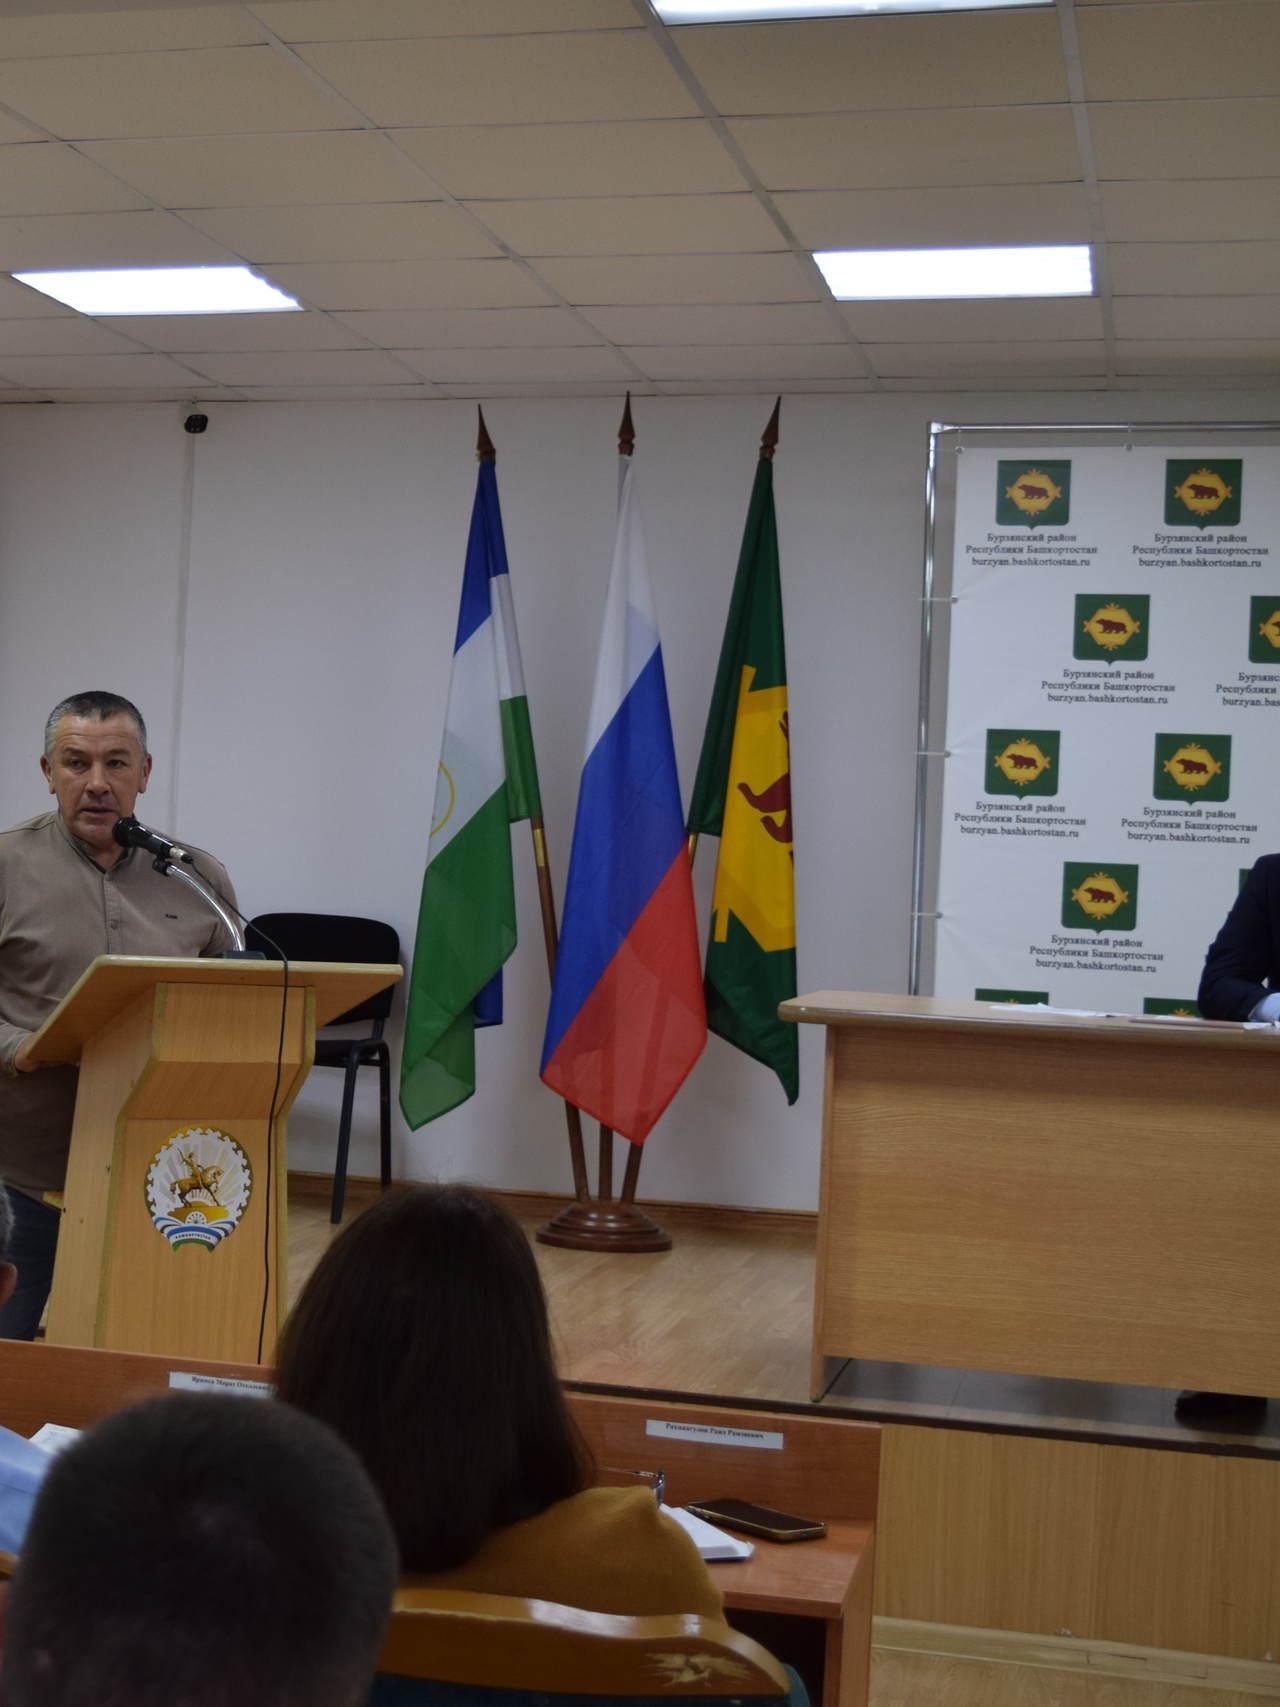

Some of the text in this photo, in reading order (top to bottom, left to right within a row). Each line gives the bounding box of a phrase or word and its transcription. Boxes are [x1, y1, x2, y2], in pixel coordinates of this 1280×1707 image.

[987, 534, 1077, 543] Бурзянский район
[1154, 534, 1247, 544] Бурзянский район
[966, 545, 1097, 555] Республики Башкортостан
[1132, 546, 1269, 556] Республики Башкортостан
[972, 557, 1090, 568] burzyan.bashkortostan.ru
[1139, 557, 1261, 569] burzyan.bashkortostan.ru
[1063, 669, 1154, 680] Бурзянский район
[1041, 680, 1175, 693] Республики Башкортостан
[1215, 684, 1277, 695] Республики
[1048, 692, 1168, 704] burzyan.bashkortostan.ru
[976, 802, 1065, 813] Бурзянский район
[1143, 806, 1236, 820] Бурзянский район
[954, 812, 1086, 827] Республики Башкортостан
[1121, 818, 1258, 833] Республики Башкортостан
[960, 825, 1079, 837] burzyan.bashkortostan.ru
[1127, 831, 1250, 844] burzyan.bashkortostan.ru
[1051, 934, 1143, 948] Бурзянский район
[1029, 946, 1164, 961] Республики Башкортостан
[1036, 959, 1156, 972] burzyan.bashkortostan.ru
